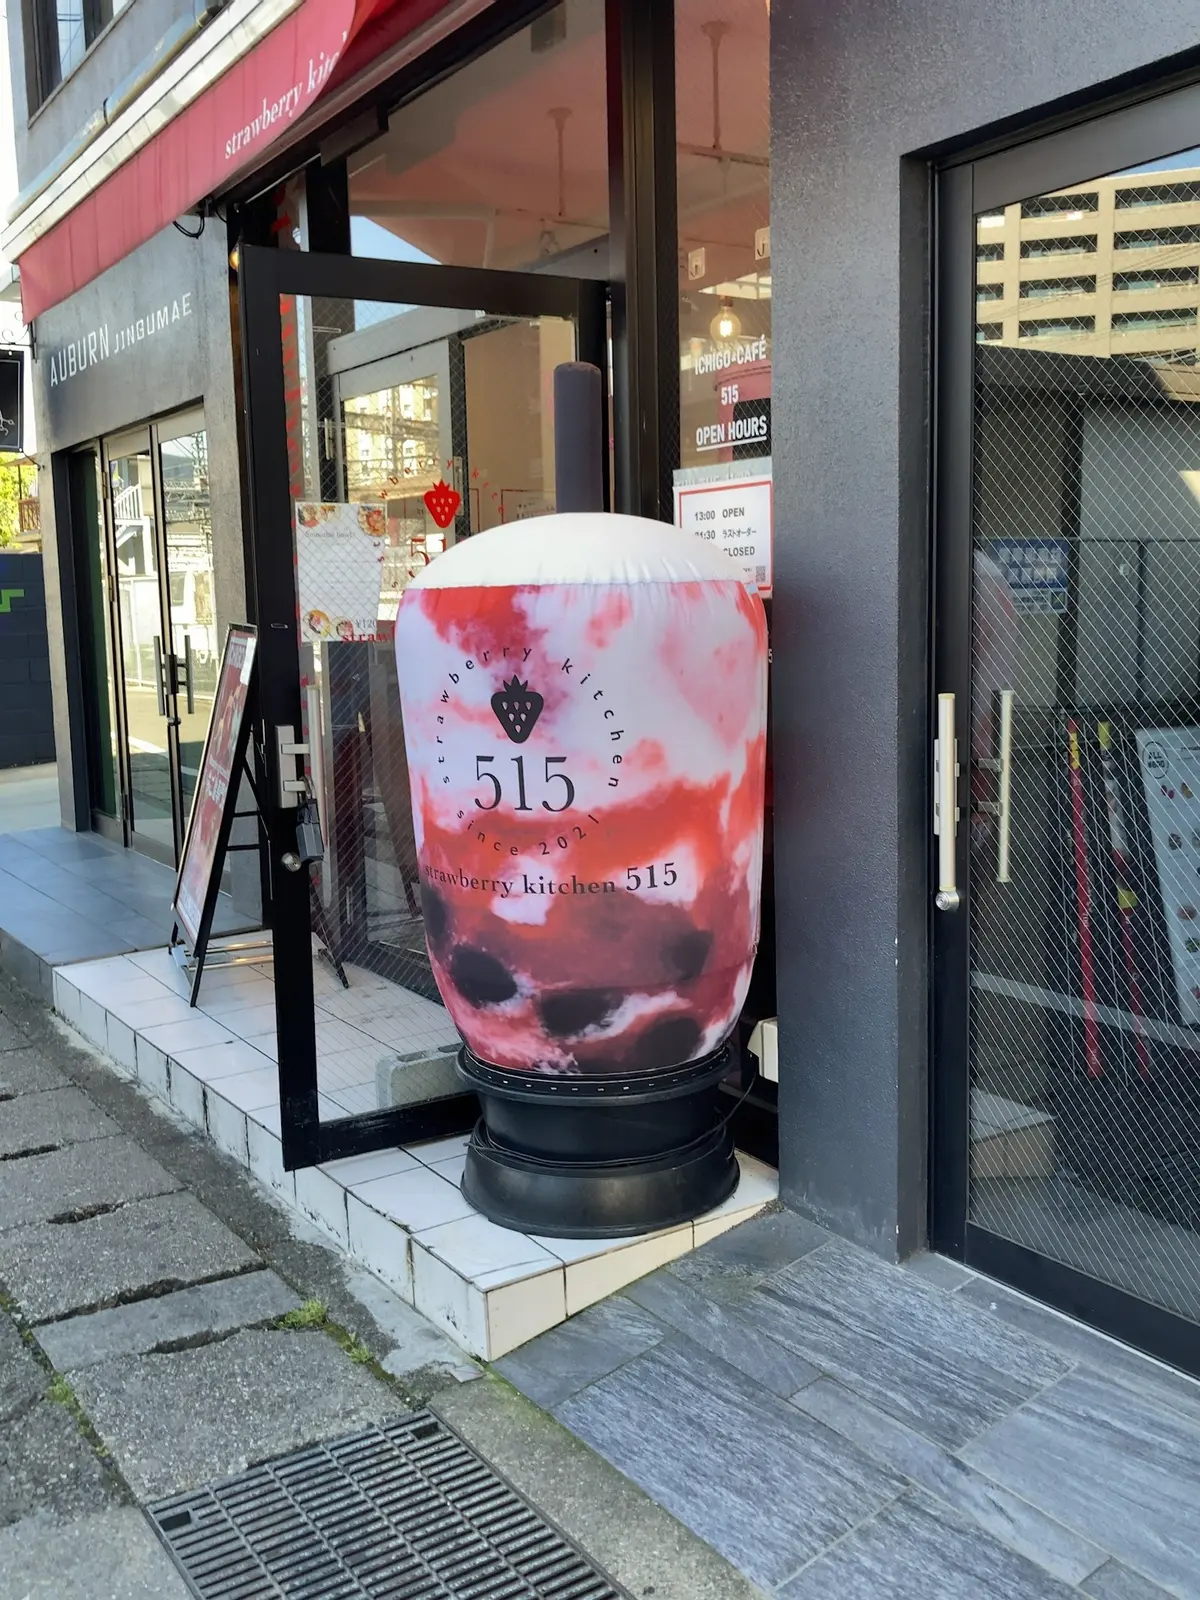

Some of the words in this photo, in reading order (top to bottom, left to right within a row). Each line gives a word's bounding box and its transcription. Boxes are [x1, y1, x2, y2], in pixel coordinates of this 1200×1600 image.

[224, 82, 303, 160] strawberry
[49, 323, 110, 388] AUBURN
[113, 292, 193, 354] JINGUMAE
[721, 384, 739, 406] 515
[695, 421, 725, 446] OPEN
[727, 414, 768, 441] HOURS
[695, 510, 716, 521] 13:00
[722, 507, 745, 518] OPEN
[722, 527, 758, 539] ラストオーダー
[436, 646, 532, 785] strawberry
[561, 658, 624, 788] kitchen
[474, 755, 575, 812] 515
[456, 809, 518, 856] since
[539, 813, 600, 856] 2021
[424, 864, 513, 898] strawberry
[523, 874, 616, 895] kitchen
[626, 862, 678, 893] 515
